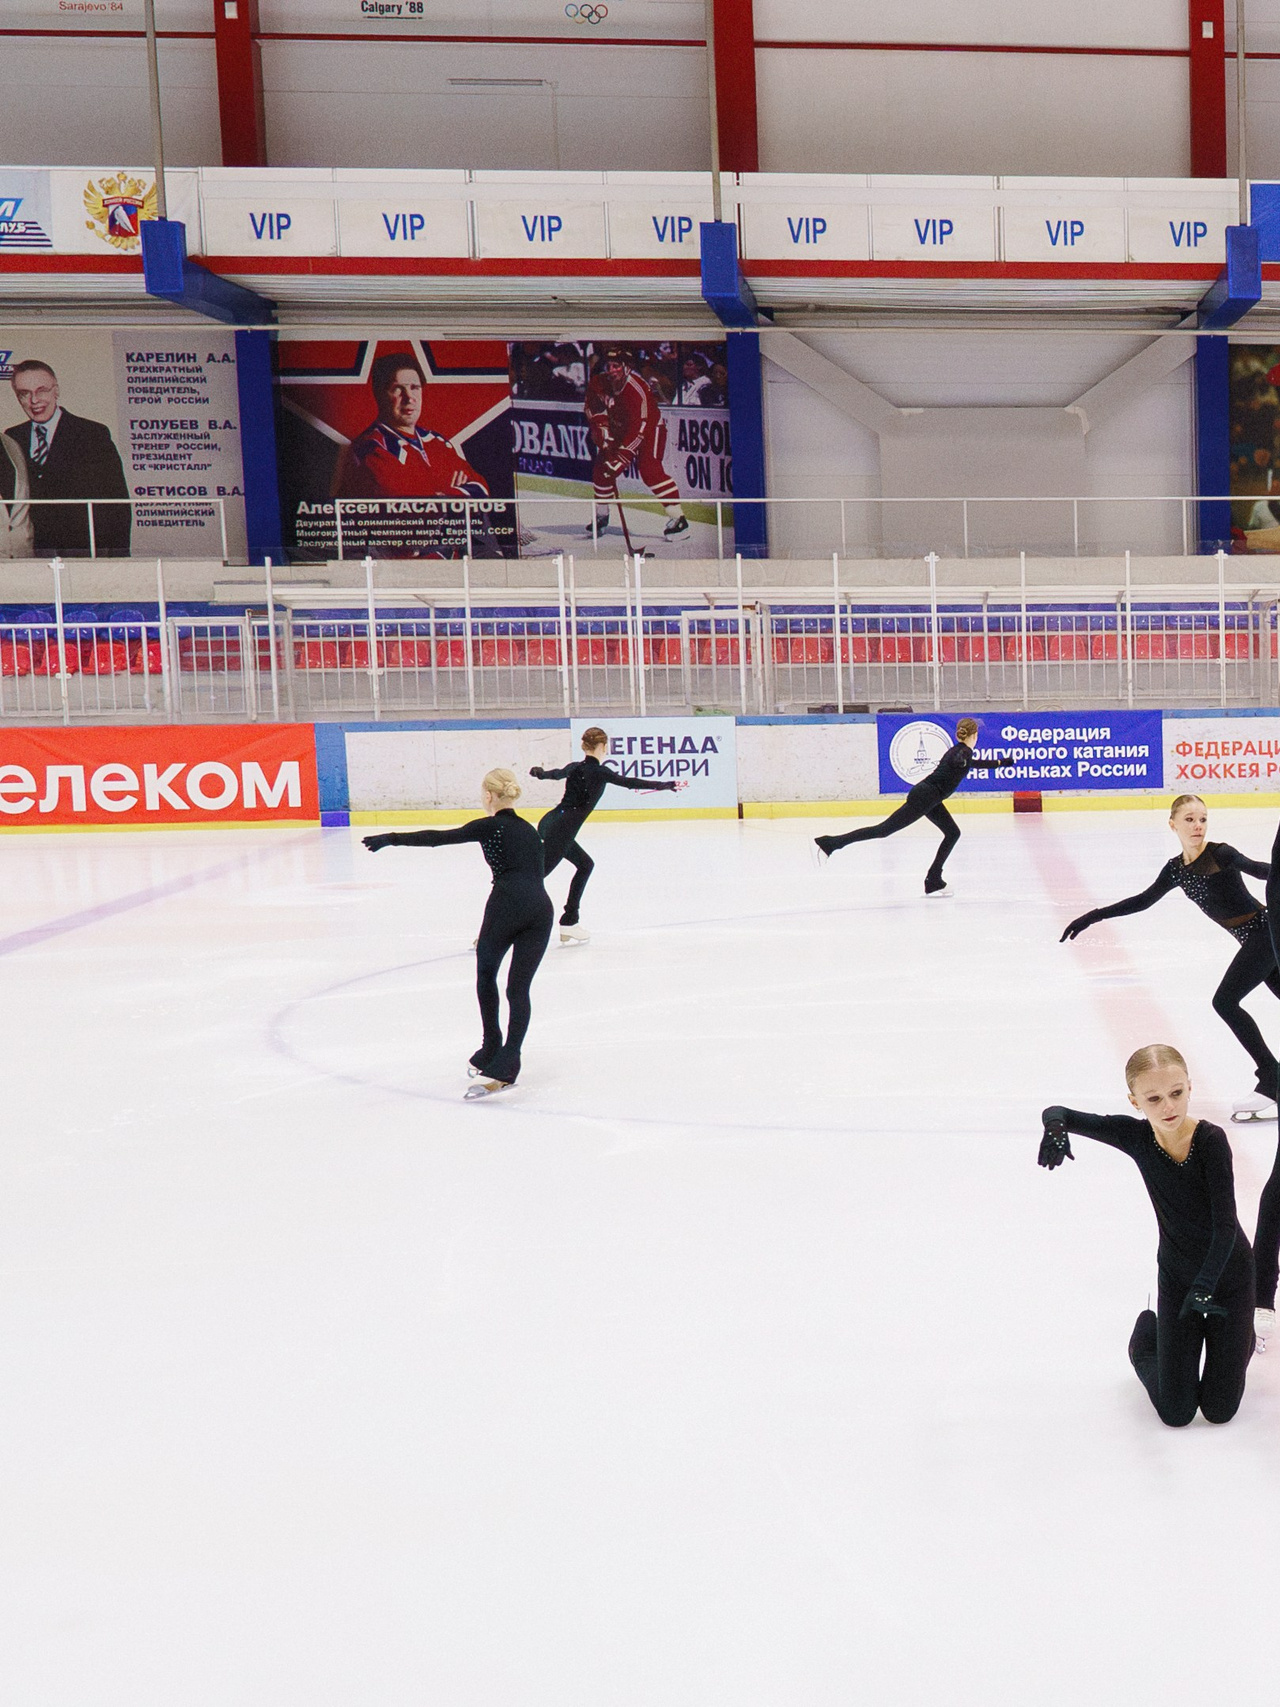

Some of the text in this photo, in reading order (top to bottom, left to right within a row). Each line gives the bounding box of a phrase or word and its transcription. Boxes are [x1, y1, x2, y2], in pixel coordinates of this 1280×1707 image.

[59, 1, 107, 12] Sarajevo
[361, 0, 402, 14] Calgary
[249, 212, 291, 240] VIP
[382, 213, 425, 241] VIP
[521, 215, 563, 243] VIP
[652, 216, 693, 244] VIP
[787, 217, 827, 244] VIP
[914, 218, 954, 245] VIP
[1046, 219, 1085, 246] VIP
[1169, 220, 1208, 247] VIP
[126, 353, 235, 363] КАРЕЛИН А.А.
[126, 365, 203, 373] ТРЕХКРАТНЫЙ
[127, 375, 207, 384] ОЛИМПИЙСКИЙ
[127, 386, 200, 395] ПОБЕДИТЕЛЬ,
[128, 396, 161, 404] ГЕРОЙ
[130, 420, 237, 430] ГОЛУБЕВ В.А.
[130, 432, 210, 440] ЗАСЛУЖЕННЫЙ
[131, 443, 221, 452] ТРЕНЕР РОССИИ,
[132, 453, 193, 461] ПРЕЗИДЕНТ
[132, 463, 146, 471] СК
[686, 454, 711, 491] ON
[134, 485, 245, 496] ФЕТИСОВ В.А.
[135, 508, 215, 517] ОЛИМПИЙСКИЙ
[136, 519, 205, 528] ПОБЕДИТЕЛЬ
[295, 517, 483, 528] Двукратый олимпийский победитль
[416, 529, 444, 537] мира,
[487, 527, 514, 535] СССР
[405, 539, 439, 547] спорта
[1001, 725, 1111, 744] Федерация
[607, 736, 719, 755] ЕГЕНДА
[1073, 745, 1150, 760] катания
[966, 761, 1148, 780] на коньках России
[1175, 762, 1260, 780] ХОККЕЯ
[0, 761, 301, 814] елеком
